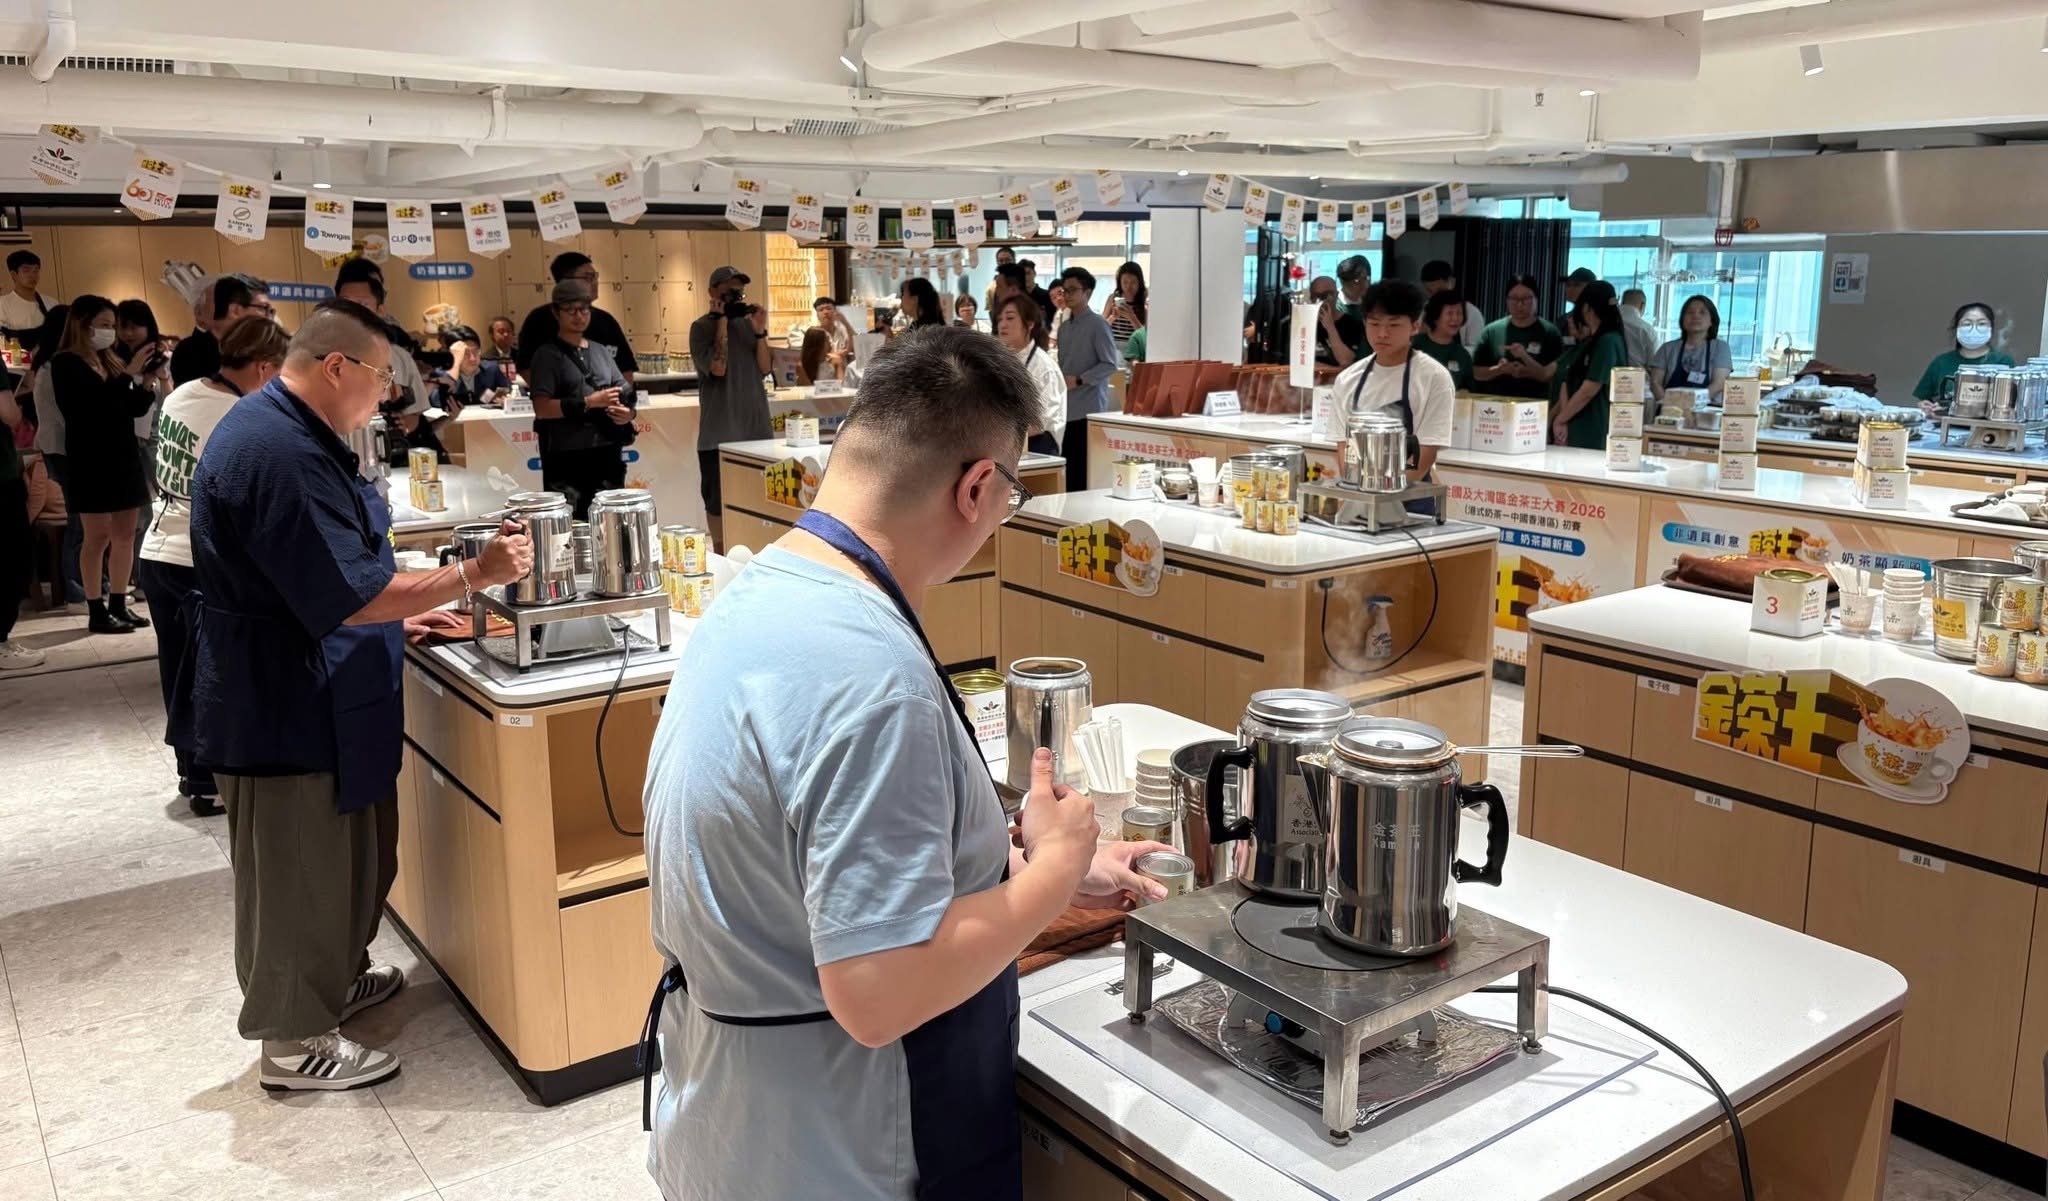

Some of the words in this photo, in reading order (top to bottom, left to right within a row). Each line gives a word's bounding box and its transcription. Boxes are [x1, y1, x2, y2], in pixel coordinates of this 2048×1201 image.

[320, 231, 351, 241] Towngas
[391, 235, 407, 243] CLP
[612, 282, 622, 292] 10
[687, 282, 694, 291] 2
[1116, 474, 1123, 487] 2
[1570, 502, 1606, 519] 2026
[1562, 520, 1582, 532] 初賽
[1520, 531, 1573, 553] 奶茶顯新風
[1674, 527, 1740, 548] 非遺具創意
[1059, 521, 1110, 584] 金茶王
[1765, 596, 1779, 615] 3
[510, 716, 521, 725] 02
[1697, 669, 1832, 775] 金茶王
[1290, 828, 1322, 837] Associati
